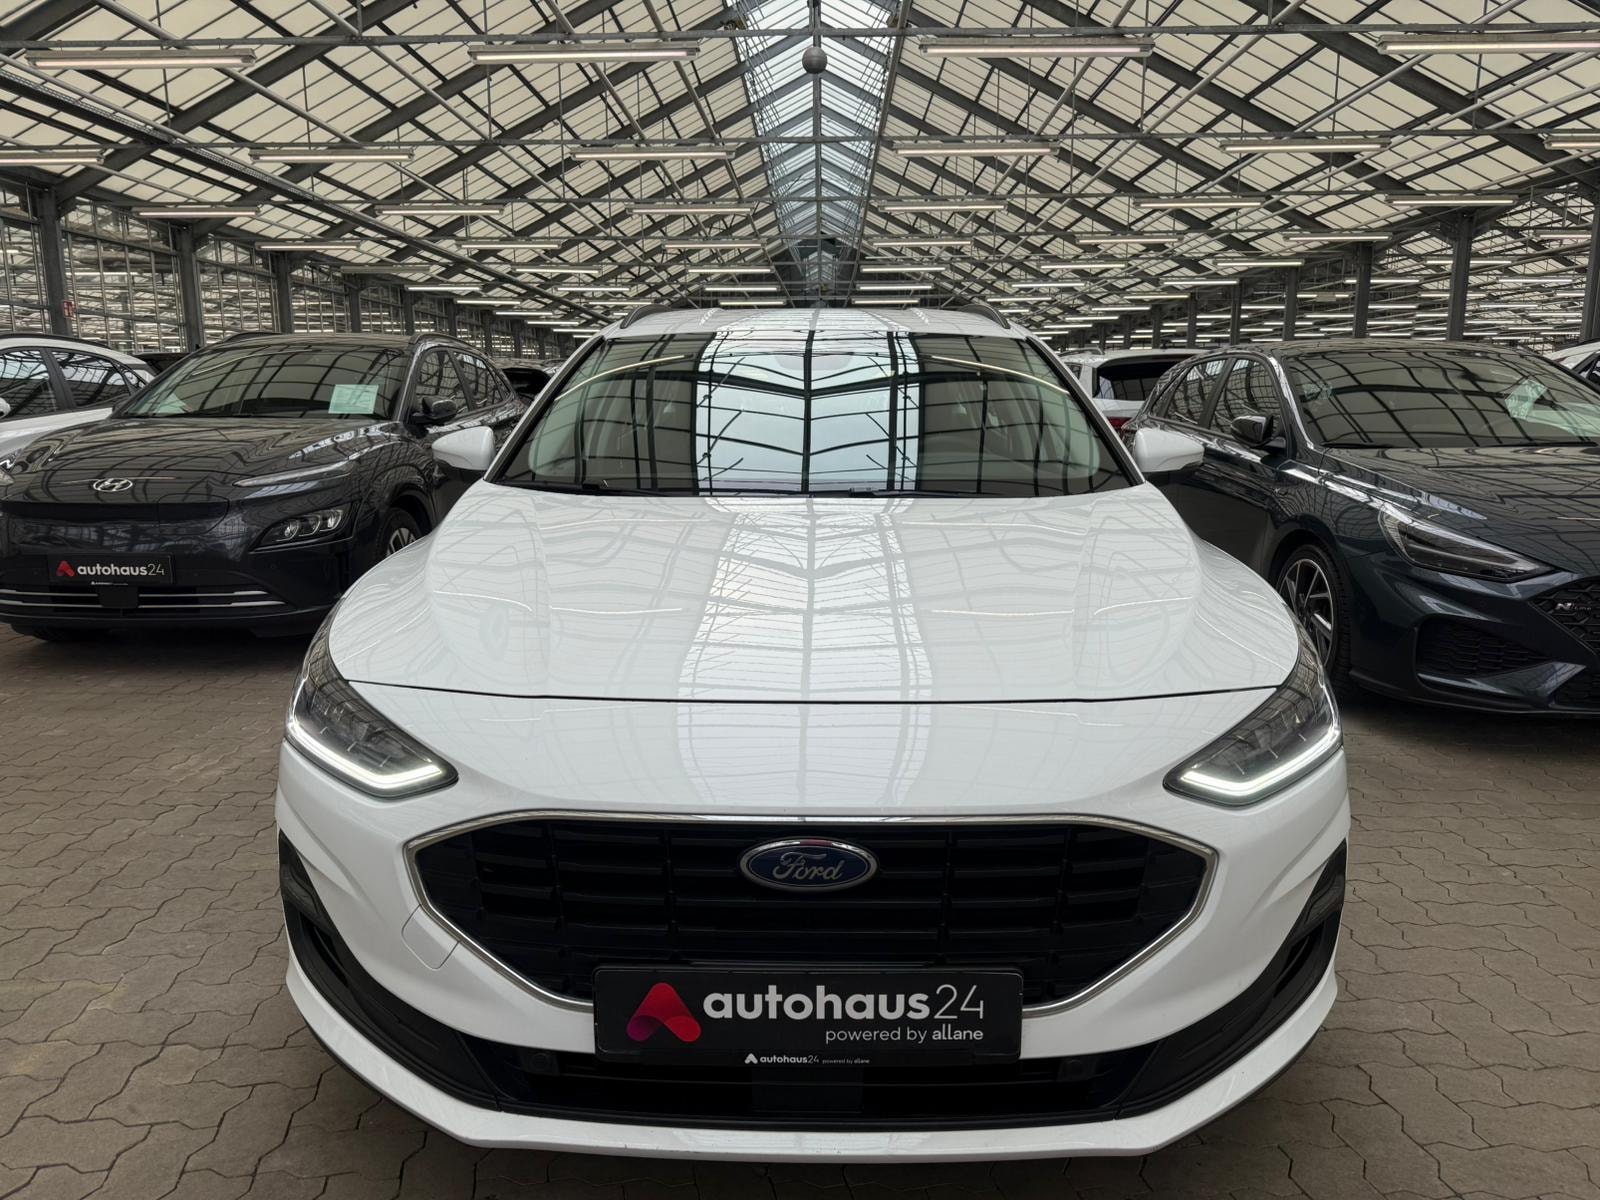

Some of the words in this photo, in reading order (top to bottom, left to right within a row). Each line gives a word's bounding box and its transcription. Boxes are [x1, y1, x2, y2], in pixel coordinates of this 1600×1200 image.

[77, 563, 165, 576] autohaus24
[772, 851, 845, 880] Ford
[702, 984, 985, 1020] autohaus24
[825, 1026, 901, 1045] powered
[906, 1026, 928, 1045] by
[932, 1024, 984, 1041] allane
[759, 1054, 820, 1064] autohaus24
